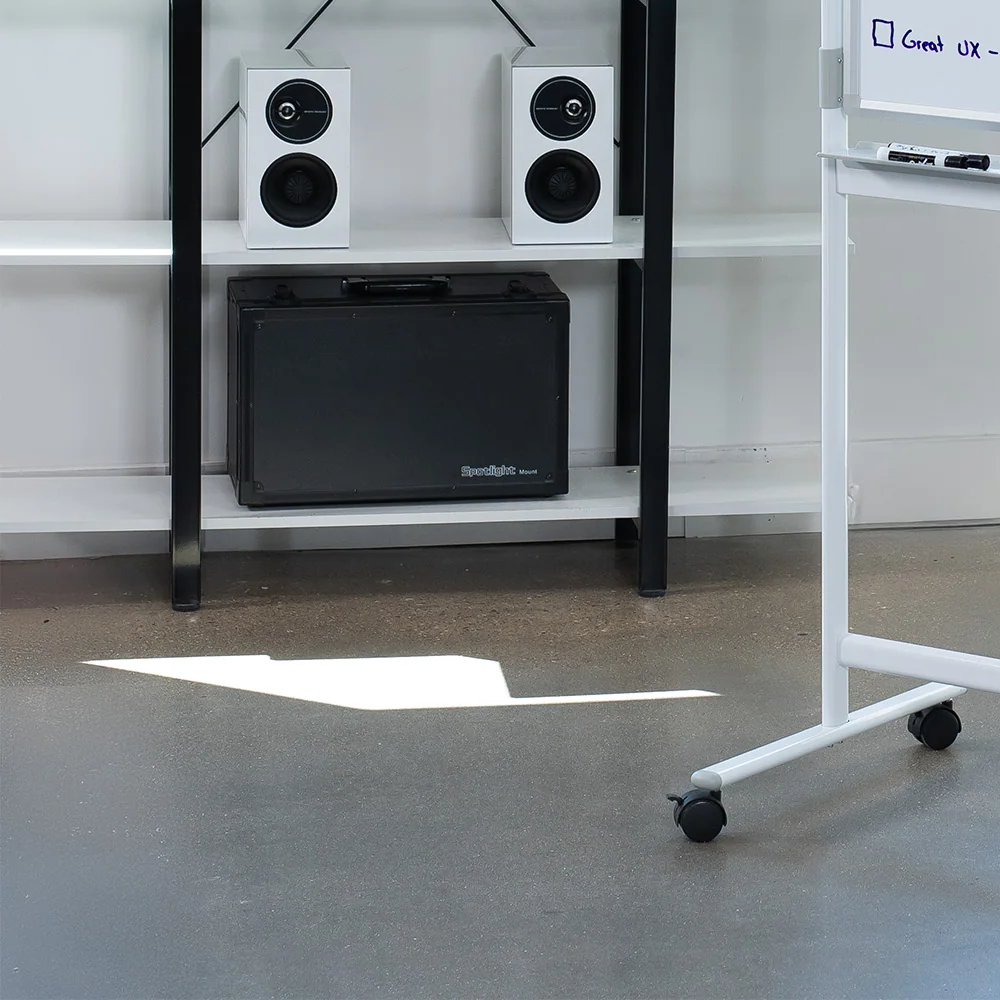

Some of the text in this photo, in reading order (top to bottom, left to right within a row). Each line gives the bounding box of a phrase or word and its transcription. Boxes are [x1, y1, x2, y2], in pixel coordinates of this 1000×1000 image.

[902, 29, 943, 53] Great
[958, 40, 980, 59] UX
[461, 464, 516, 477] Spotlight
